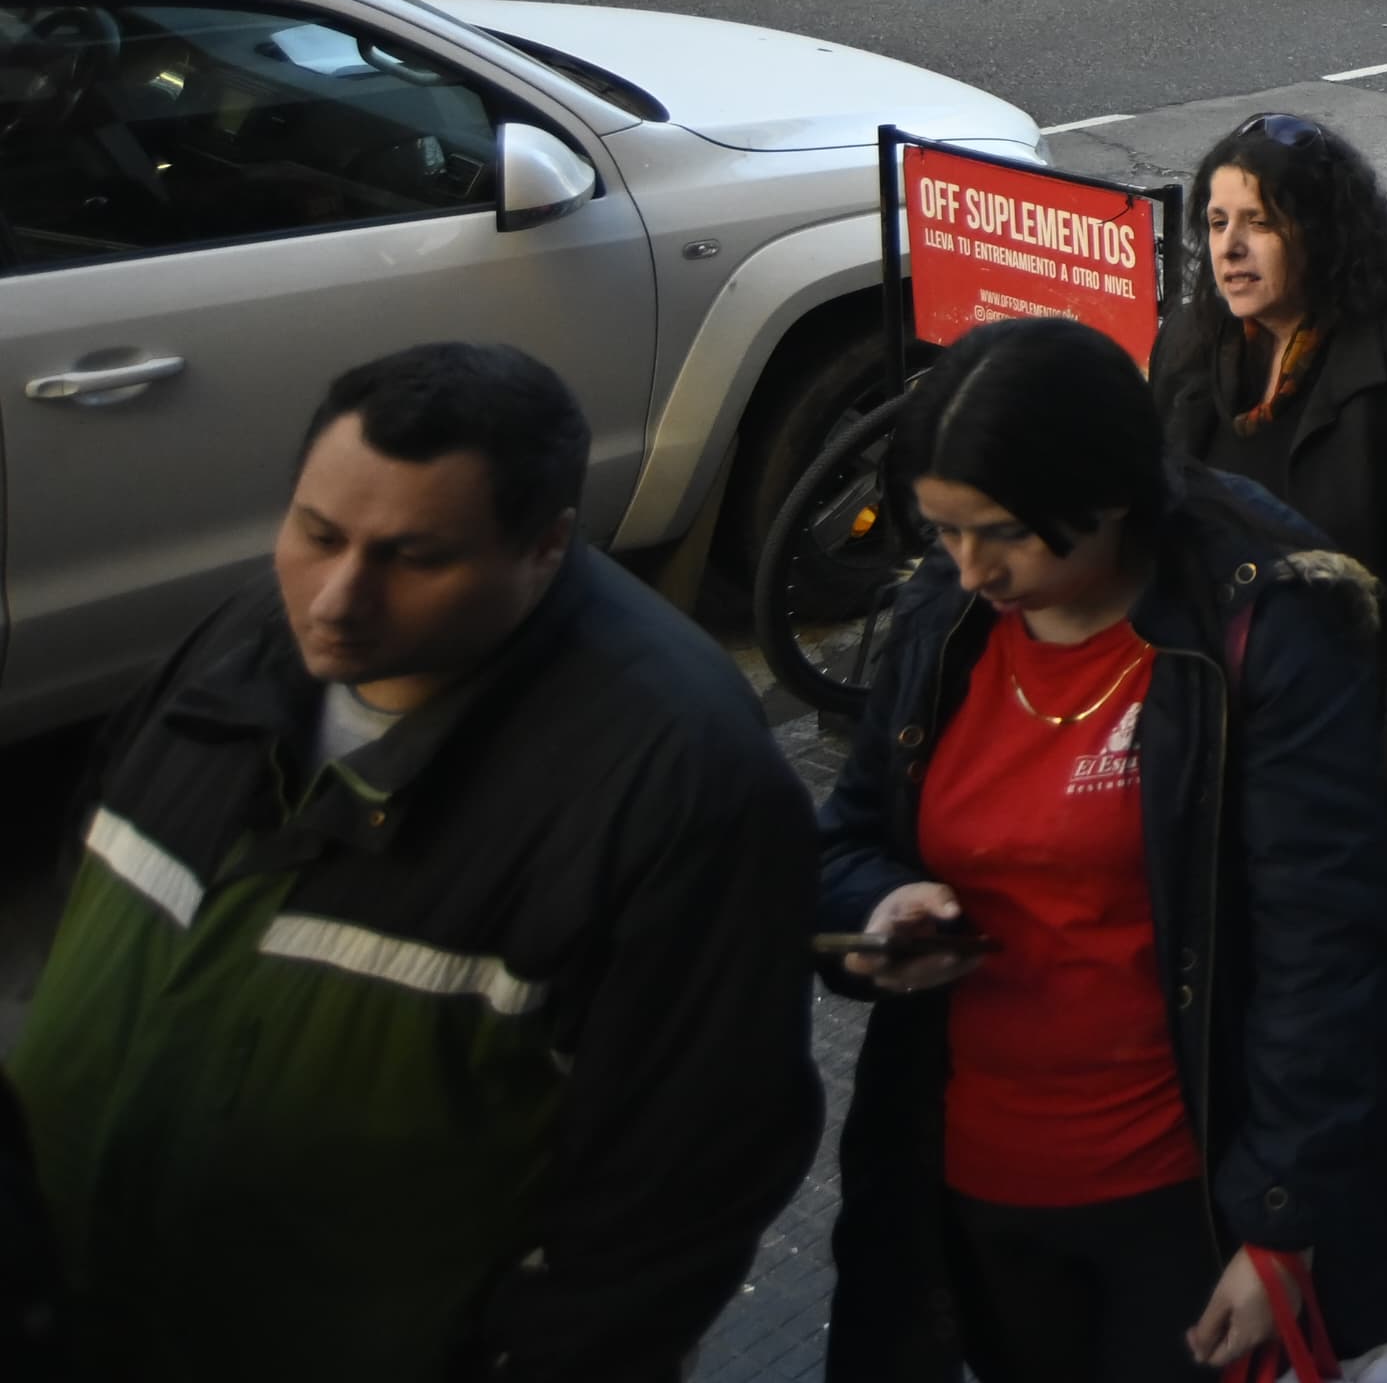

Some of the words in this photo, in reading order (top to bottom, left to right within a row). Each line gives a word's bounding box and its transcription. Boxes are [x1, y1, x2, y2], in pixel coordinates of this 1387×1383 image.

[920, 177, 960, 224] OFF
[965, 187, 1136, 269] SUPLEMENTOS
[925, 227, 955, 252] LLEVA
[957, 235, 971, 257] TU
[975, 240, 1057, 280] ENTRENAMIENTO
[1060, 263, 1069, 282] A
[1072, 266, 1100, 291] OTRO
[1104, 271, 1136, 300] NIVEL
[1074, 759, 1097, 777] El
